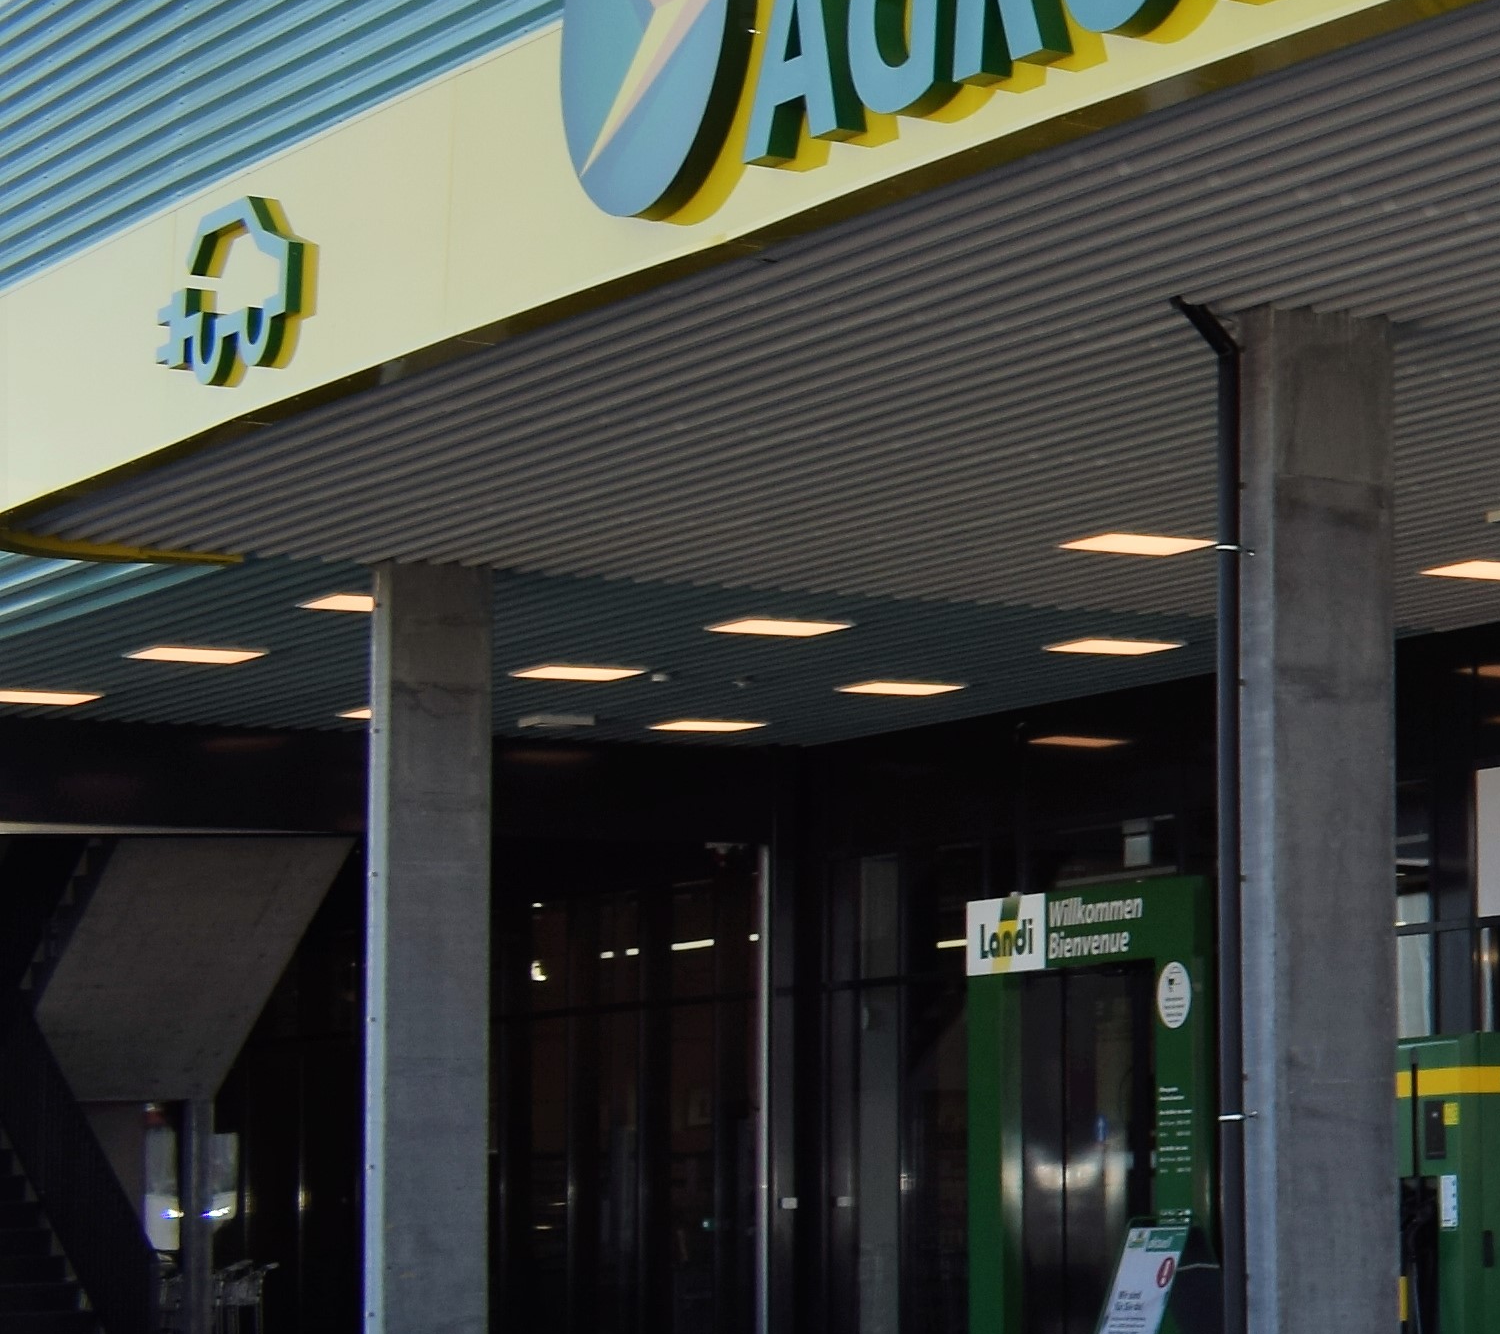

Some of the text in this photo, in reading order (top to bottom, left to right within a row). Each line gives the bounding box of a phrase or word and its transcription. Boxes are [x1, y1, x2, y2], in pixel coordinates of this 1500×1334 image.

[1050, 897, 1143, 927] Willkommen
[980, 919, 1033, 959] Landi
[1050, 931, 1130, 959] Bienvenue
